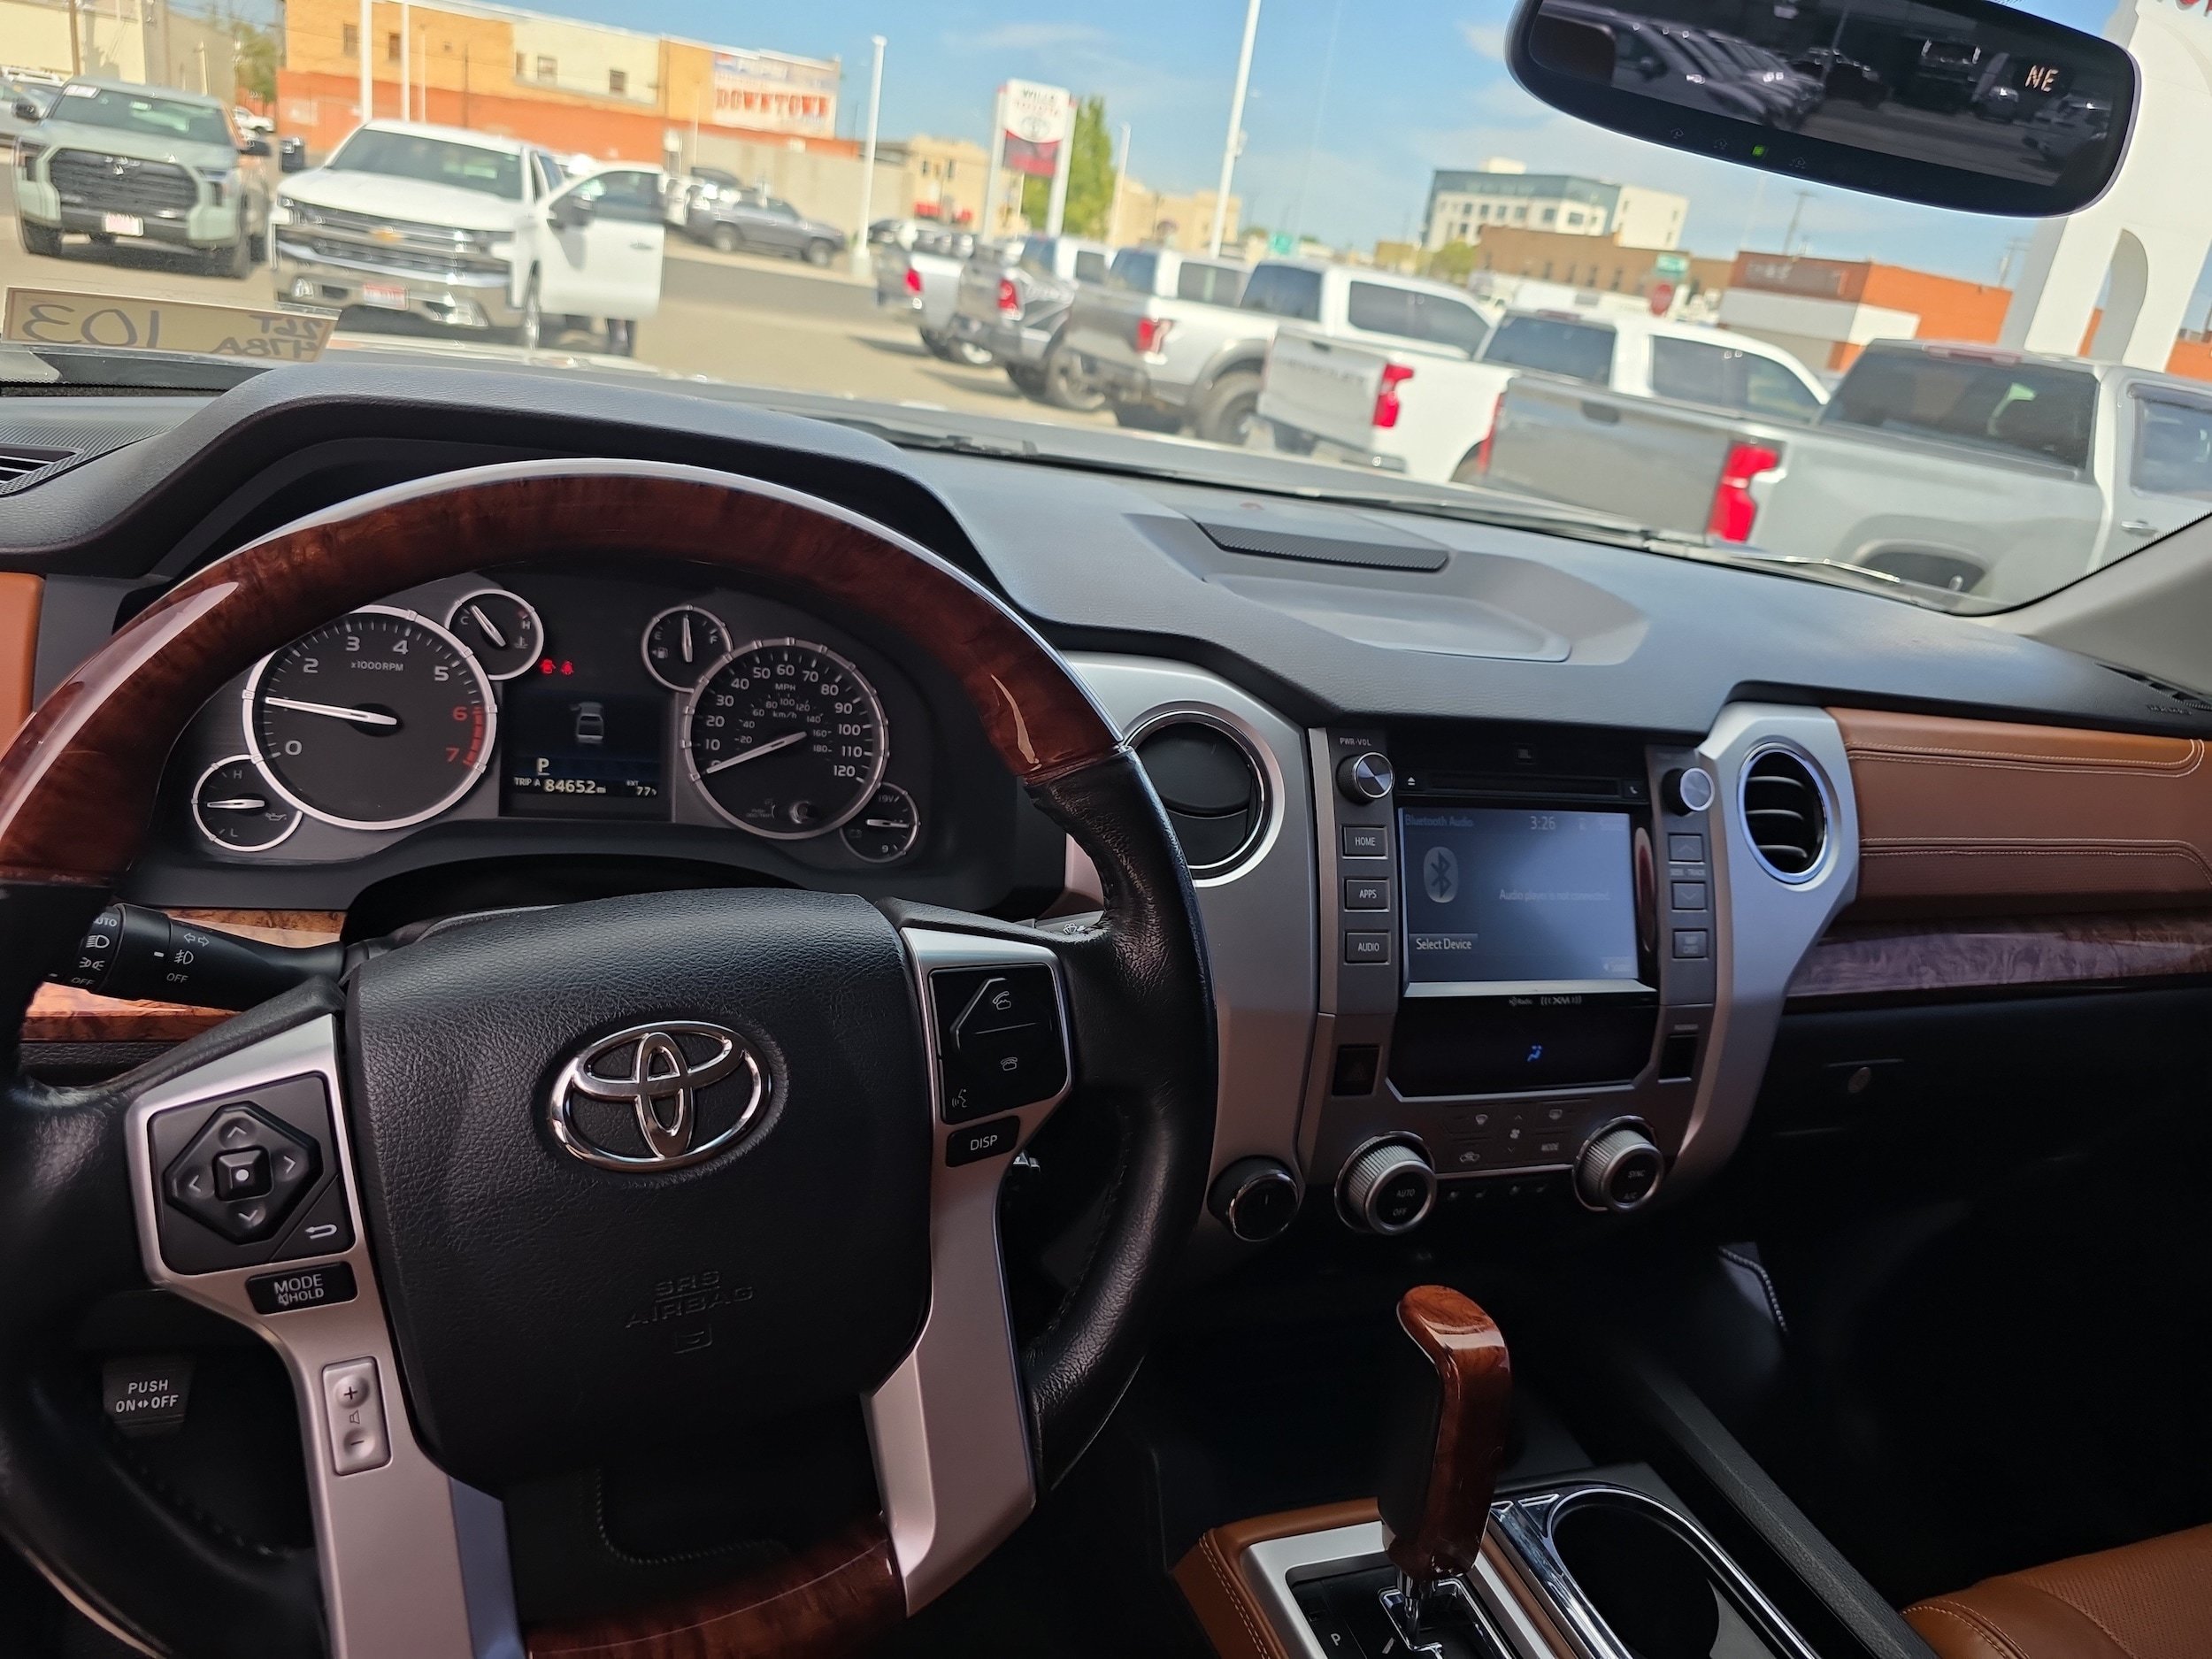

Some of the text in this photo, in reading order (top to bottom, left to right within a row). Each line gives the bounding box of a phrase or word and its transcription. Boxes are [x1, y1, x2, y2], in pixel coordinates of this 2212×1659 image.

[2024, 65, 2060, 92] NE
[460, 616, 469, 626] C
[521, 619, 531, 629] H
[346, 636, 360, 651] 3
[393, 640, 408, 655] 4
[303, 658, 319, 673] 2
[777, 664, 795, 676] 60
[434, 666, 449, 681] 5
[754, 667, 771, 679] 50
[803, 671, 818, 683] 70
[731, 679, 749, 689] 40
[821, 684, 839, 695] 80
[717, 695, 734, 707] 30
[453, 706, 467, 721] 6
[835, 703, 853, 714] 90
[706, 716, 725, 727] 20
[839, 724, 861, 736] 100
[285, 741, 302, 756] 0
[706, 739, 720, 750] 10
[446, 748, 459, 763] 7
[841, 746, 863, 757] 110
[538, 757, 549, 772] P
[234, 770, 242, 779] H
[833, 765, 856, 777] 120
[514, 777, 531, 786] TRIP
[544, 779, 595, 793] 84652
[1405, 814, 1474, 827] Bluetooth Audio
[1530, 816, 1556, 830] 3:26
[231, 828, 238, 837] L
[1355, 837, 1376, 846] HOME
[1359, 889, 1377, 899] APPS
[1500, 889, 1523, 900] Audio
[1358, 942, 1380, 951] AUDIO
[1416, 938, 1471, 950] Select Device
[166, 973, 188, 983] OFF
[971, 1135, 998, 1150] DISP
[1396, 1188, 1416, 1197] AUTO
[274, 1274, 323, 1294] MODE
[290, 1288, 325, 1303] HOLD
[128, 1379, 169, 1394] PUSH
[116, 1394, 179, 1413] ON OFF
[1331, 1633, 1341, 1646] P
